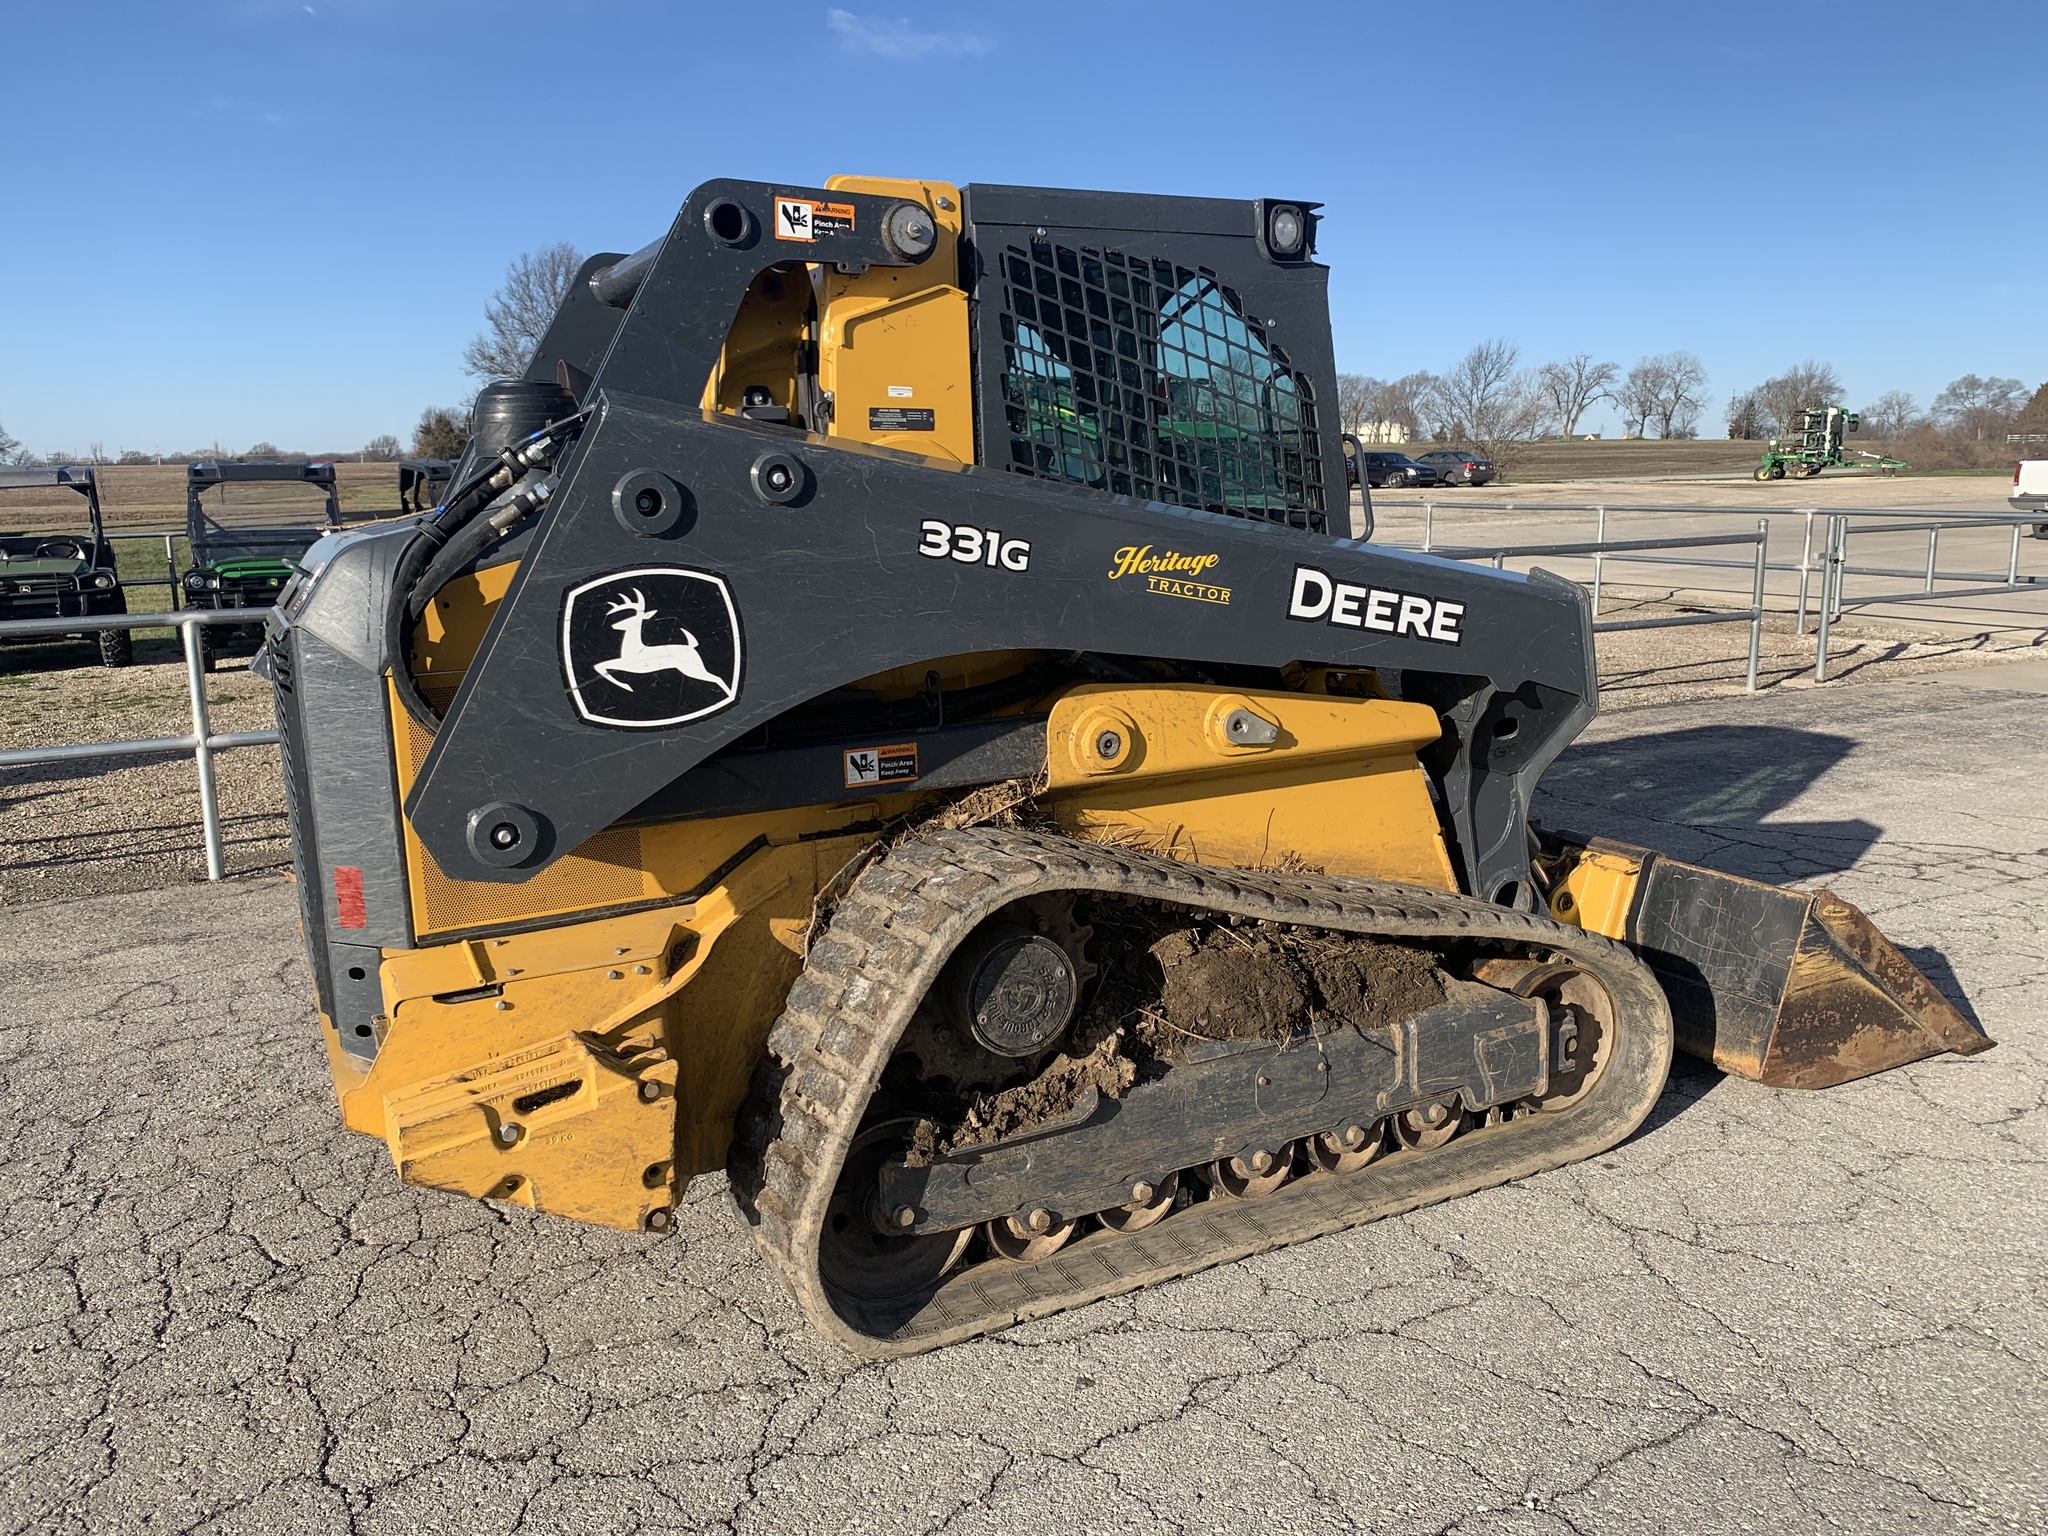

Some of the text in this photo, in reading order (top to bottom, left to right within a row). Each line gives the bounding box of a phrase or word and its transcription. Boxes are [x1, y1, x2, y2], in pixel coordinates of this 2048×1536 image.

[814, 219, 833, 229] Pinch
[919, 520, 1029, 571] 331G
[1108, 545, 1220, 580] Heritage
[1148, 578, 1231, 602] TRACTOR
[1290, 567, 1465, 643] DEERE
[886, 746, 914, 755] WARNING
[881, 761, 898, 769] Pinch
